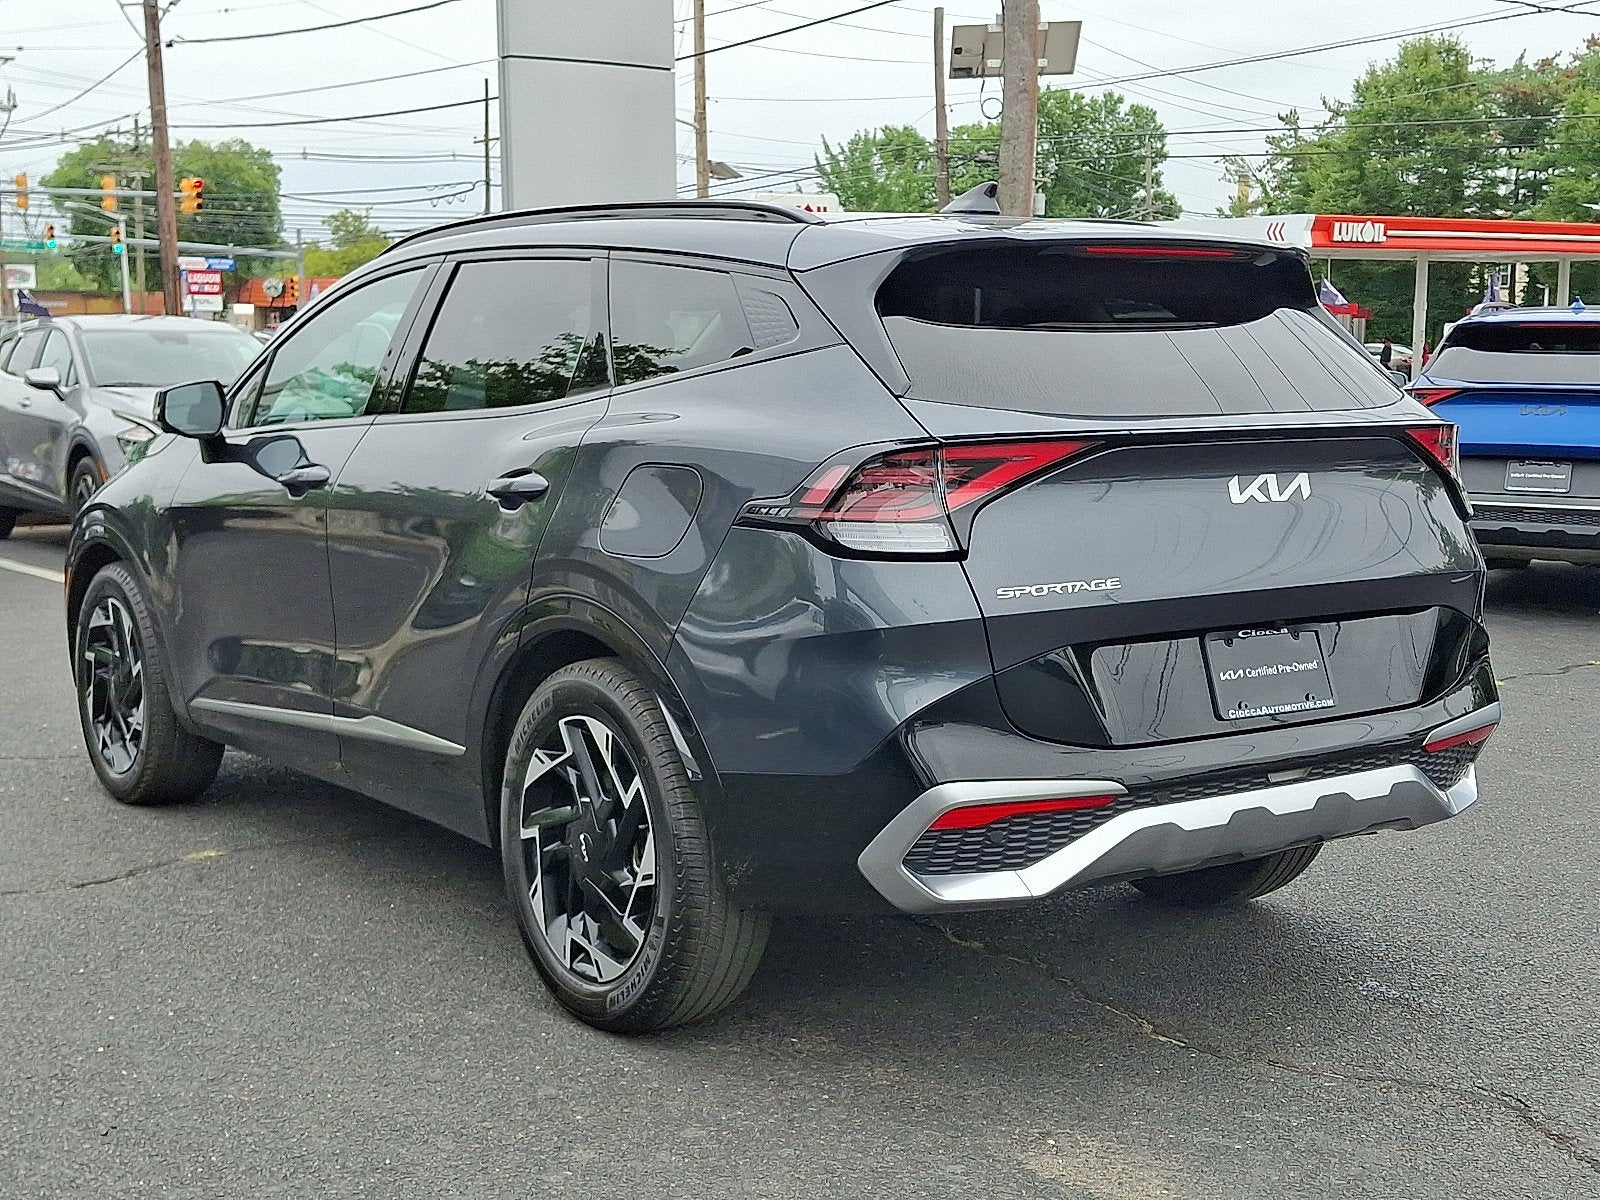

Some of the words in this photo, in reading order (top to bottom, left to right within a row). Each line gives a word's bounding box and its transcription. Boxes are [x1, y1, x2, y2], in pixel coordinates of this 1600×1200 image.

[1333, 220, 1387, 242] LUKOIL
[1228, 472, 1312, 504] KIA
[996, 577, 1122, 599] SPORTAGE
[1219, 668, 1244, 681] KIA
[1245, 664, 1278, 678] Certified
[1277, 659, 1319, 675] Pre-Owned
[514, 694, 552, 756] MICHELIN
[607, 951, 653, 1009] MICHELIN
